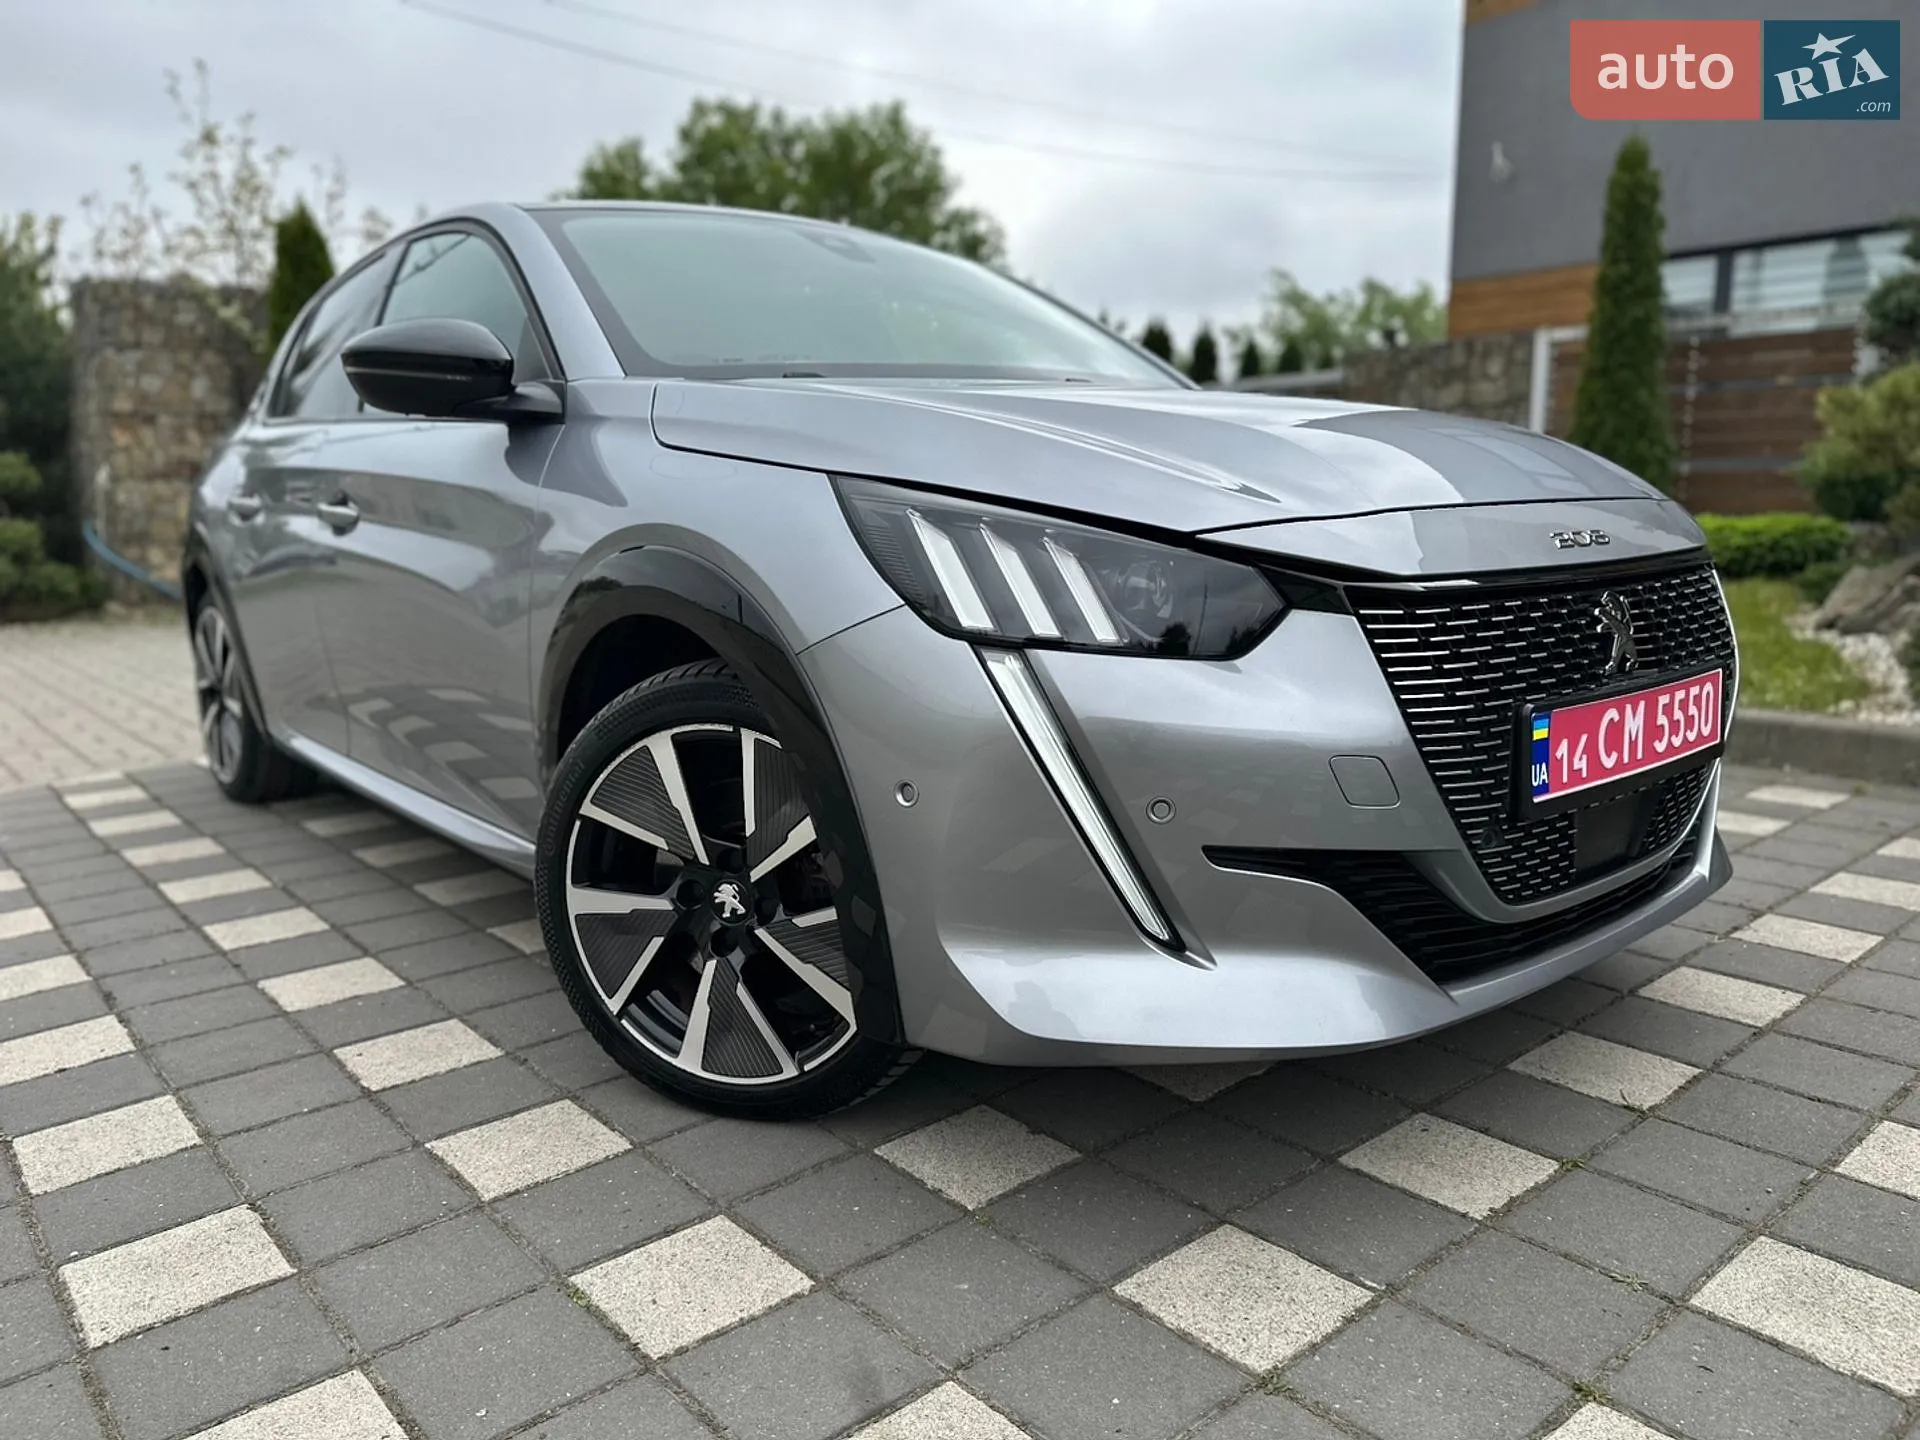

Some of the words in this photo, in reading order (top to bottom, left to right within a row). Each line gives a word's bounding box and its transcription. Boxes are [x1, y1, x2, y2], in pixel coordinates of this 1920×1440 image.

[1549, 529, 1611, 550] 208
[1555, 733, 1589, 784] 14
[1598, 700, 1646, 770] CM
[1653, 681, 1714, 754] 5550
[1531, 765, 1549, 787] UA
